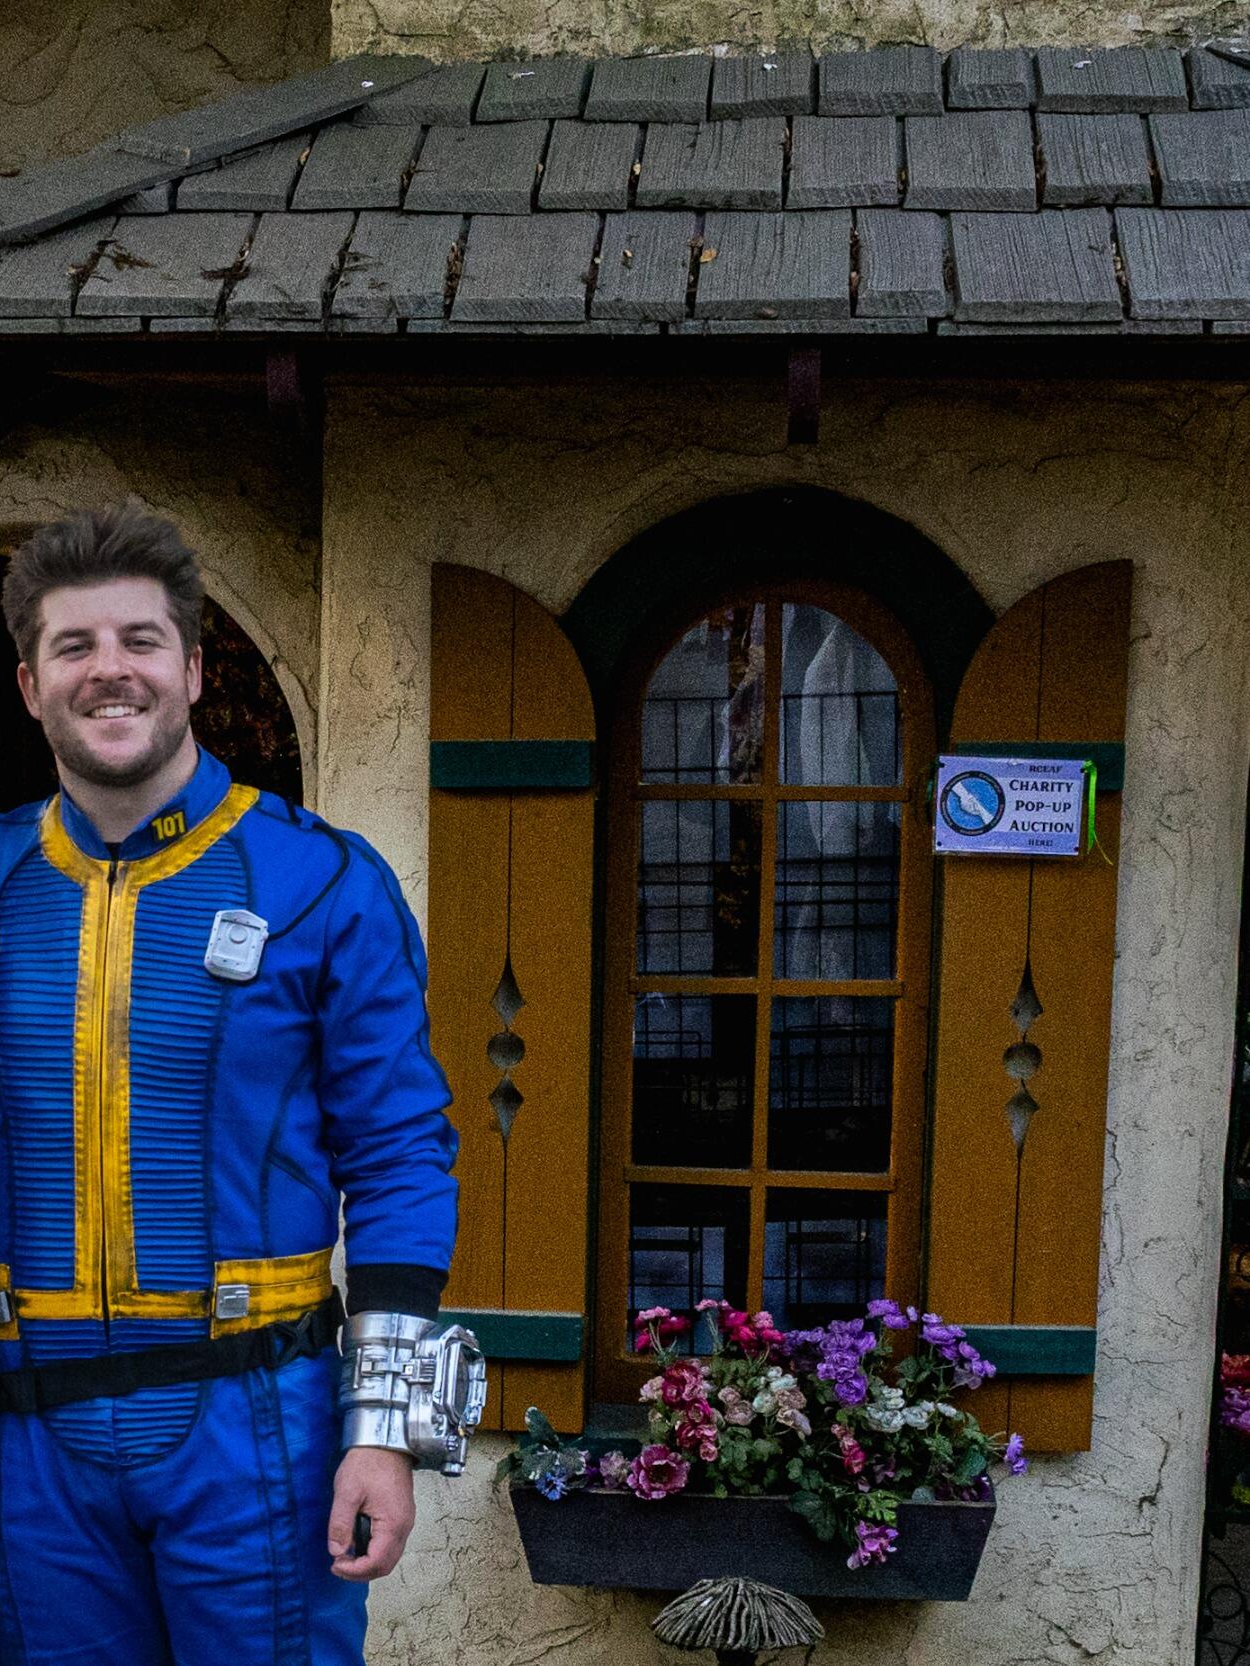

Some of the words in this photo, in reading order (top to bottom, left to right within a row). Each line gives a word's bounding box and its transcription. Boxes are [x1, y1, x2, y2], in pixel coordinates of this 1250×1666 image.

[1009, 779, 1074, 793] CHARITY
[1015, 800, 1072, 813] POP-UP
[152, 811, 186, 841] 101
[1009, 820, 1074, 833] AUCTION
